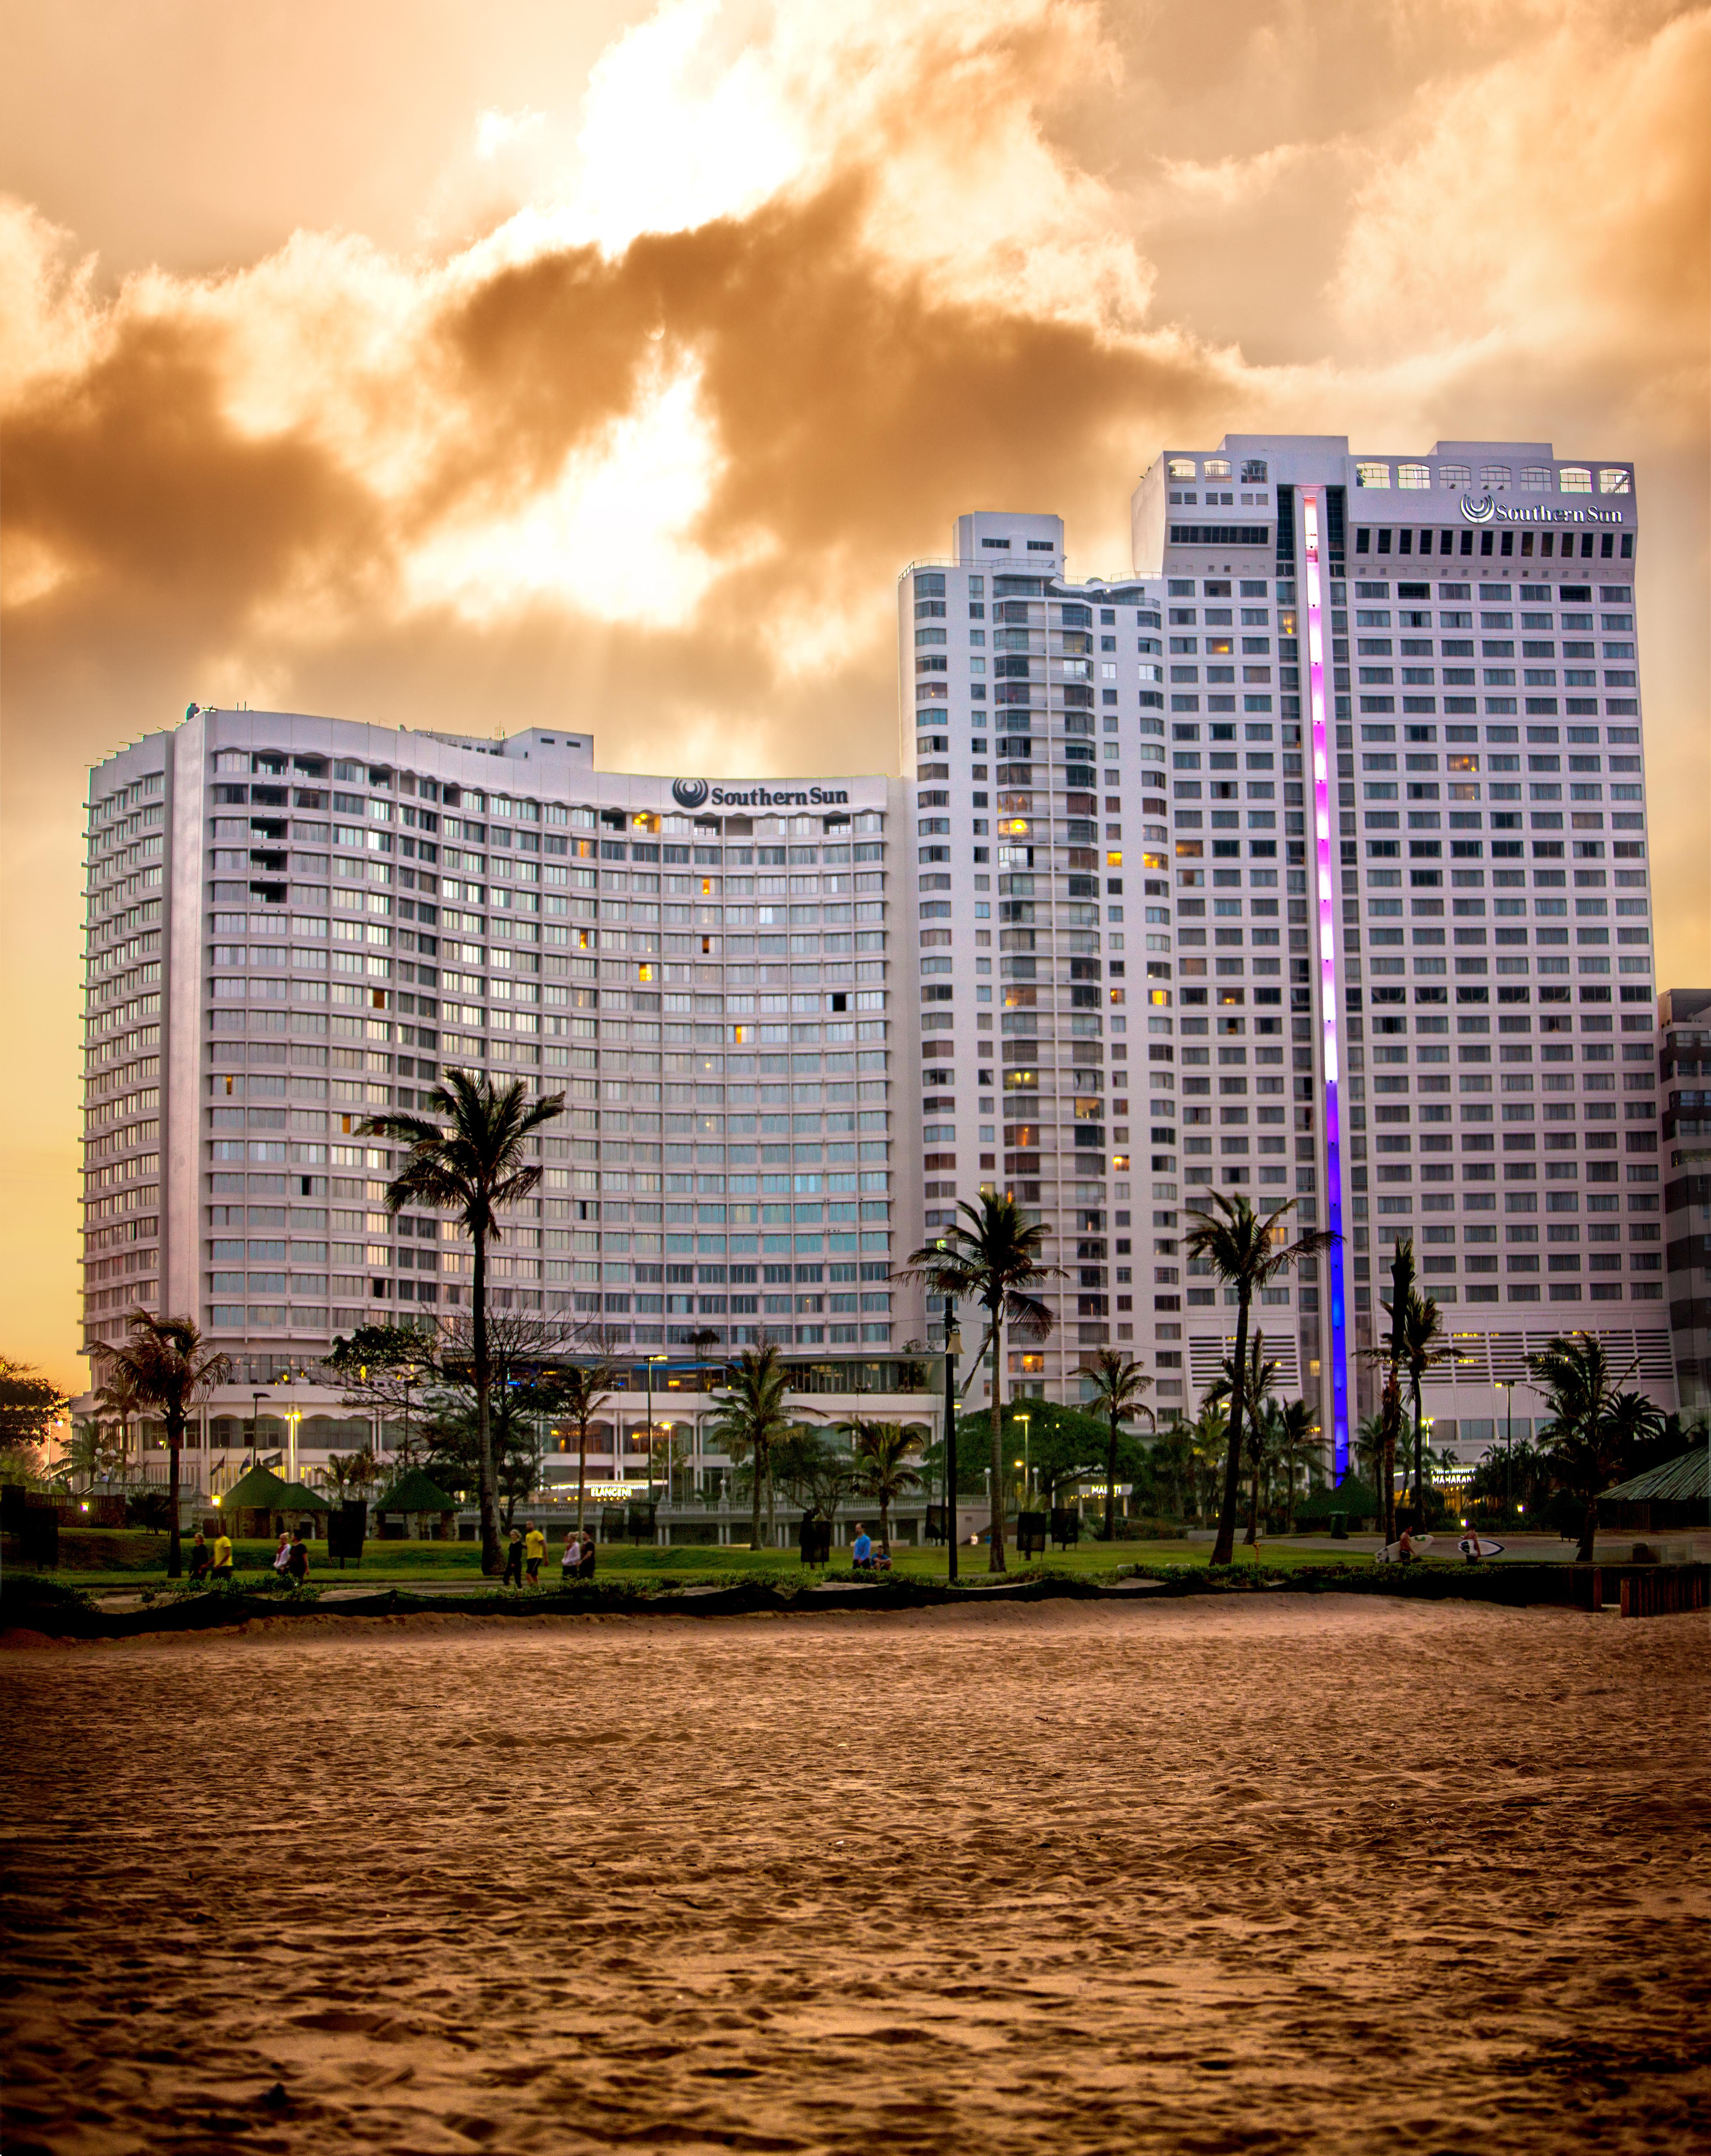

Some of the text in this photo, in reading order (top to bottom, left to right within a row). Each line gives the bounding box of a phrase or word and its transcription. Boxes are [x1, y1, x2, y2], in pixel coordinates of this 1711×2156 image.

[1496, 504, 1623, 523] Southern Sun
[712, 787, 848, 805] Southern Sun
[590, 1487, 632, 1497] ELANGENI
[1091, 1485, 1122, 1494] MALTI
